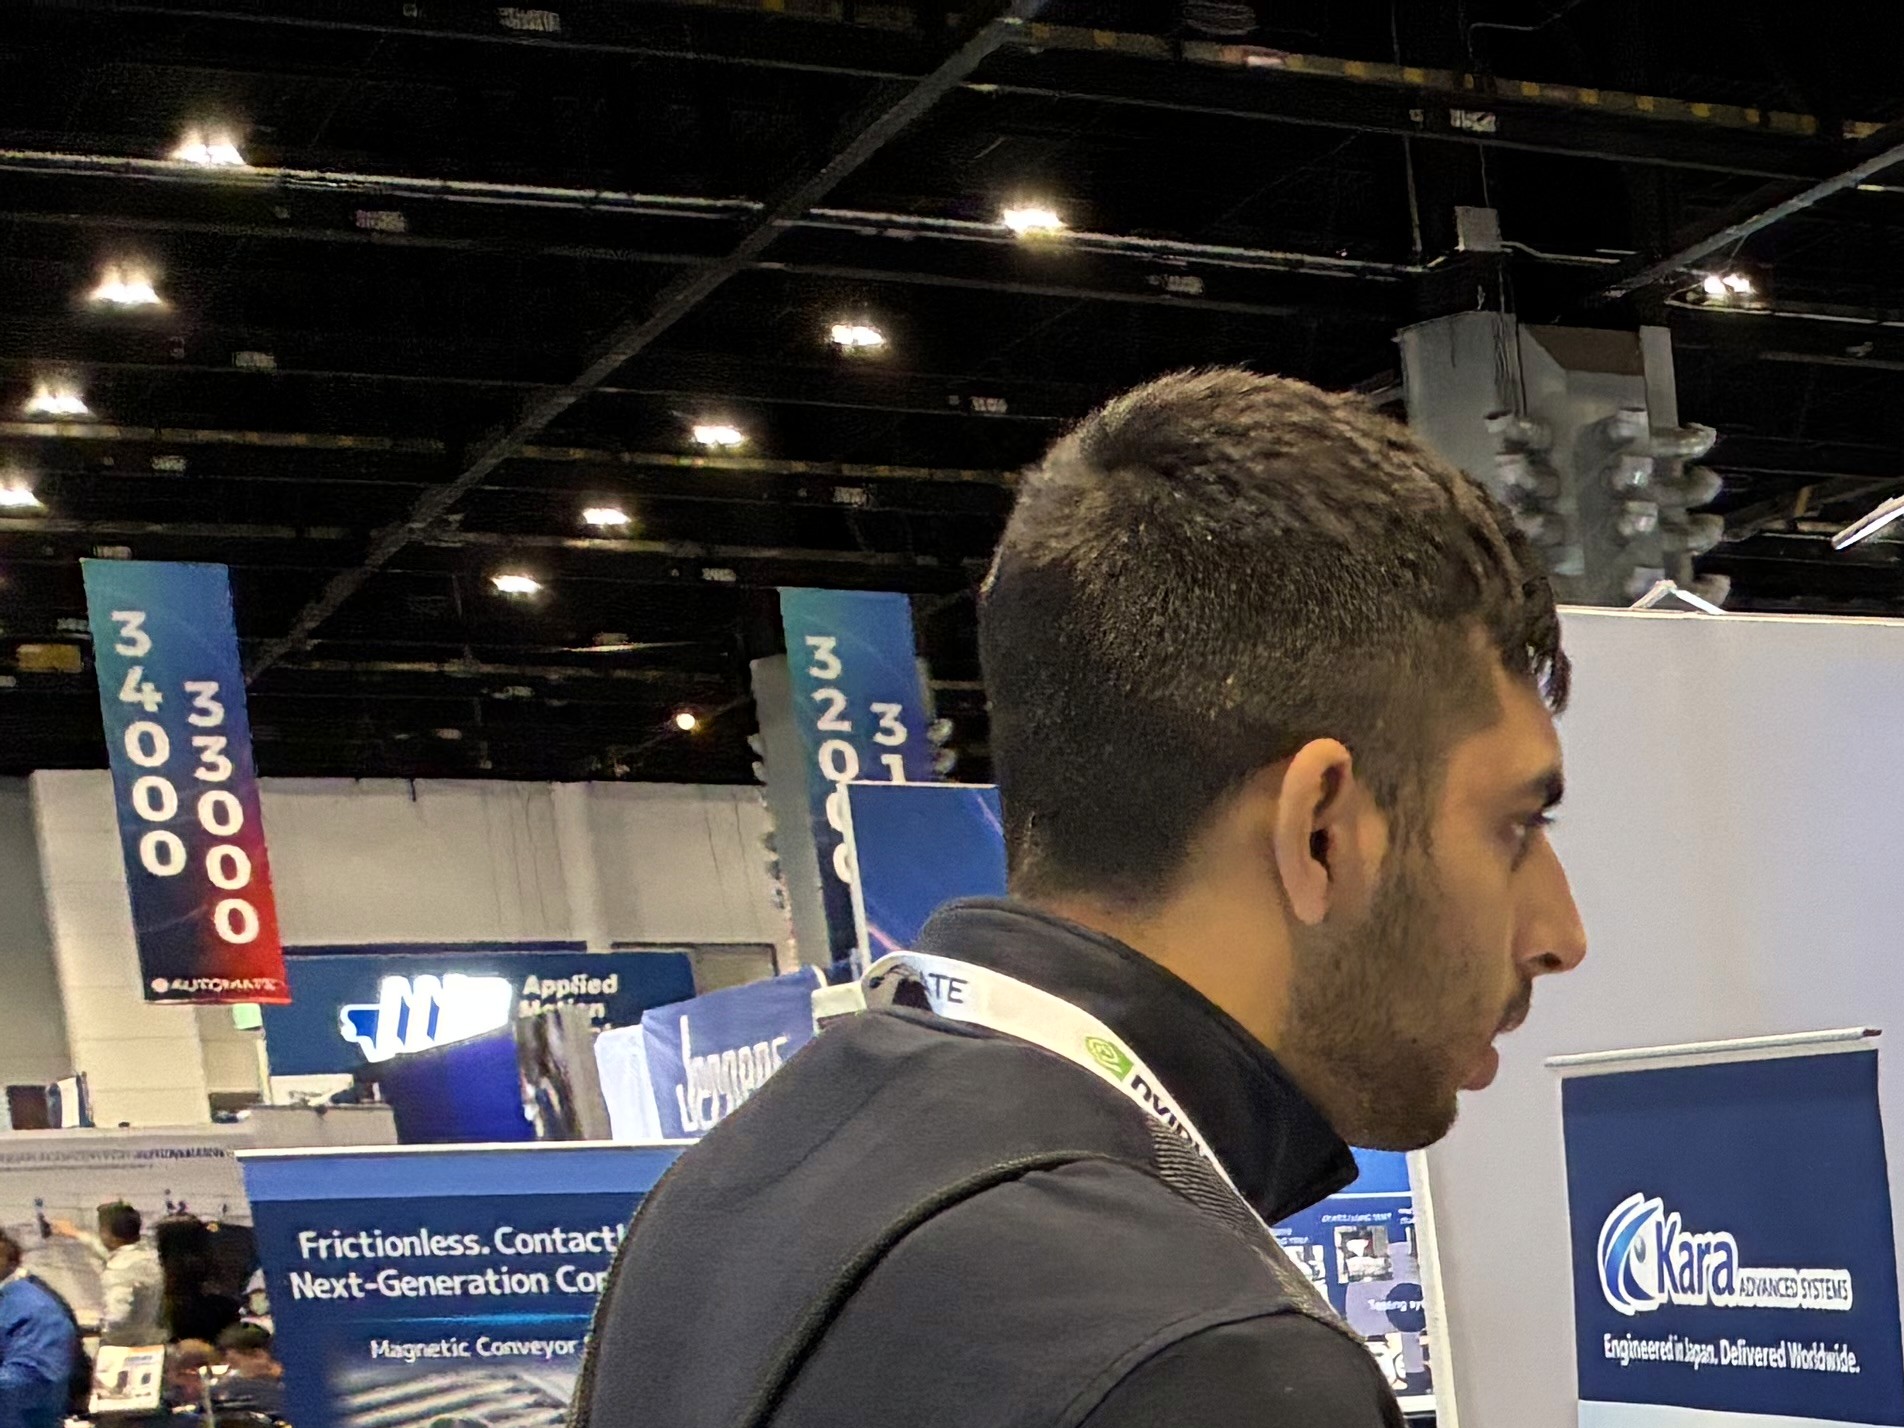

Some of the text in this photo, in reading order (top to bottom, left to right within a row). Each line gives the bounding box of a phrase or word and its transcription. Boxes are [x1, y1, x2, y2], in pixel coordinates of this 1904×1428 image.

[522, 973, 619, 999] Applied
[299, 1228, 490, 1258] Frictionless.
[1655, 1220, 1849, 1300] Kara ADVANCED SYSTEMS
[289, 1266, 549, 1299] Next-Generation
[371, 1337, 578, 1363] Magnetic Conveyor
[1603, 1333, 1673, 1367] Engineered
[1720, 1339, 1786, 1368] Delivered
[1787, 1341, 1860, 1373] Worldwide.
